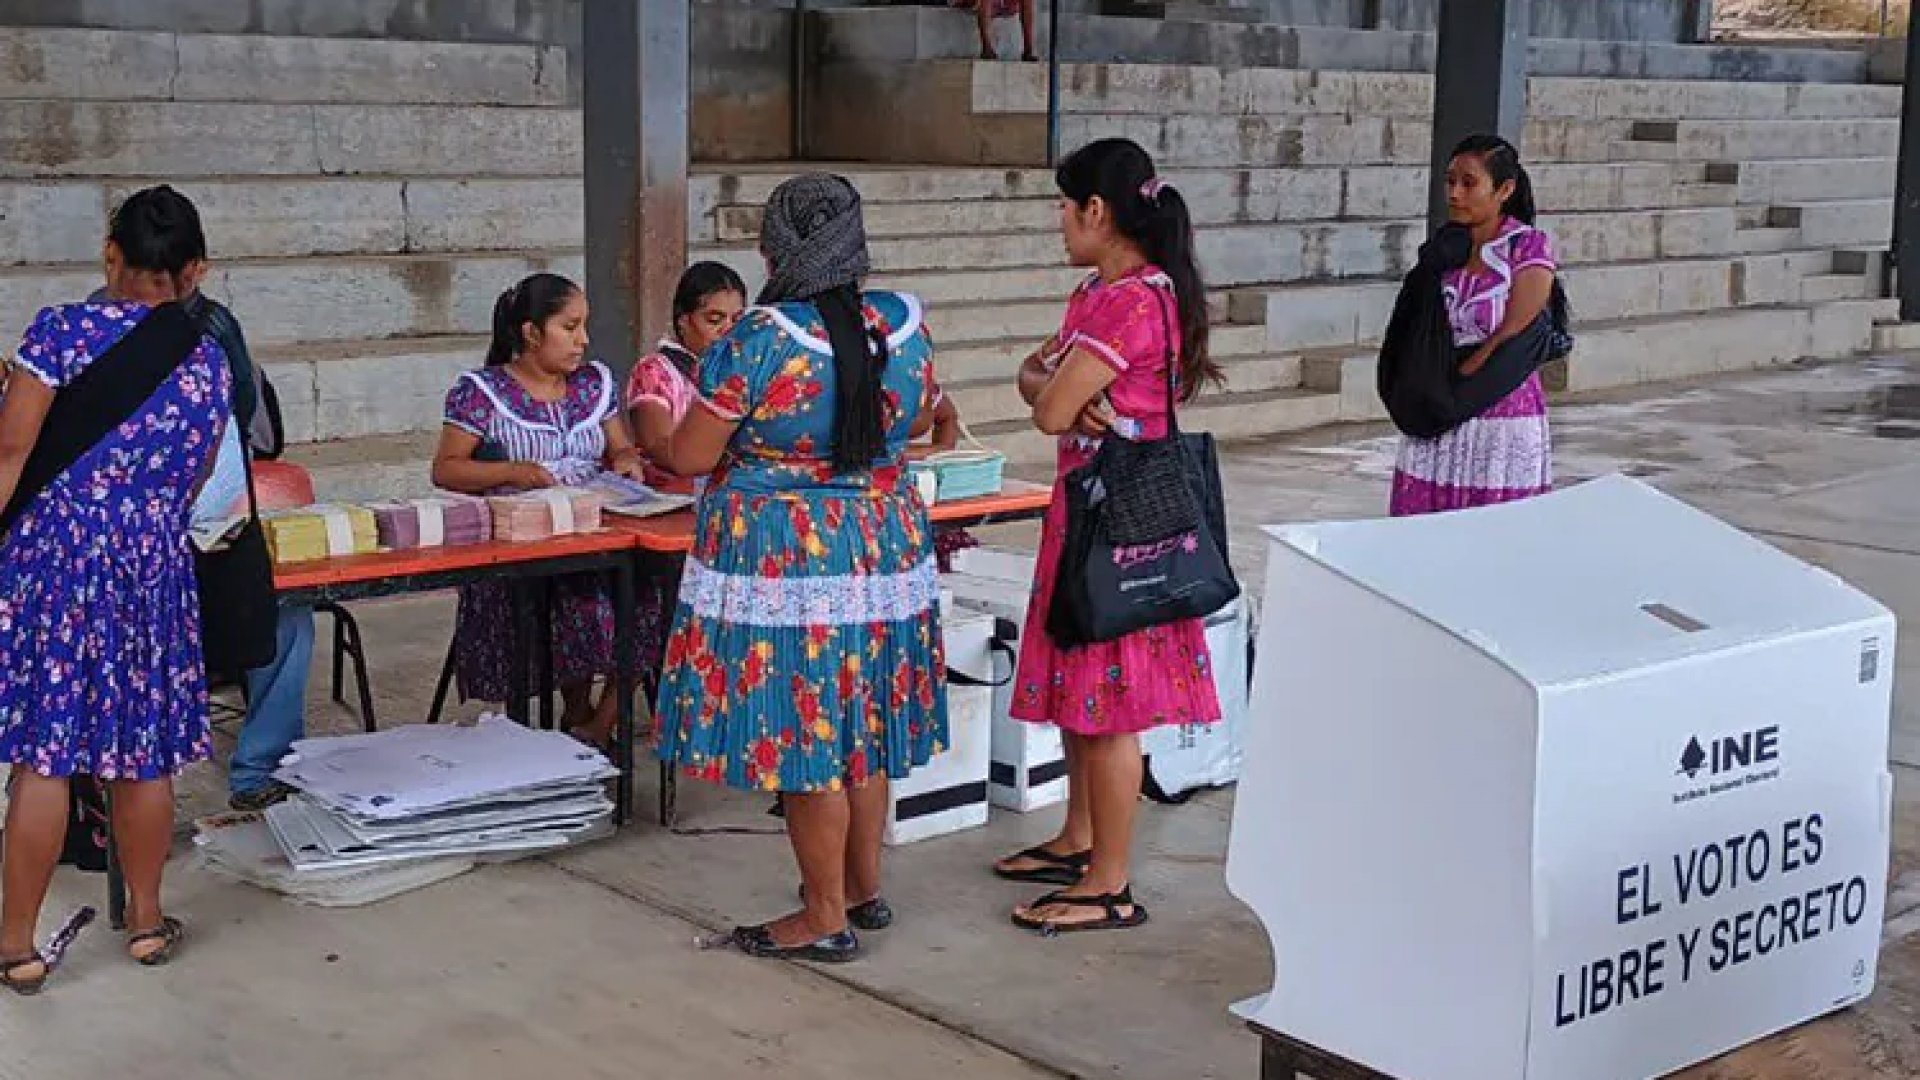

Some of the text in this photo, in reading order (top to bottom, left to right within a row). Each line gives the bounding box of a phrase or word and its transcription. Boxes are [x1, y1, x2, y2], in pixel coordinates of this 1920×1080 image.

[1711, 724, 1779, 775] INE
[1617, 813, 1824, 925] EL VOTO ES
[1555, 874, 1867, 1028] LIBRE Y SECRETO
